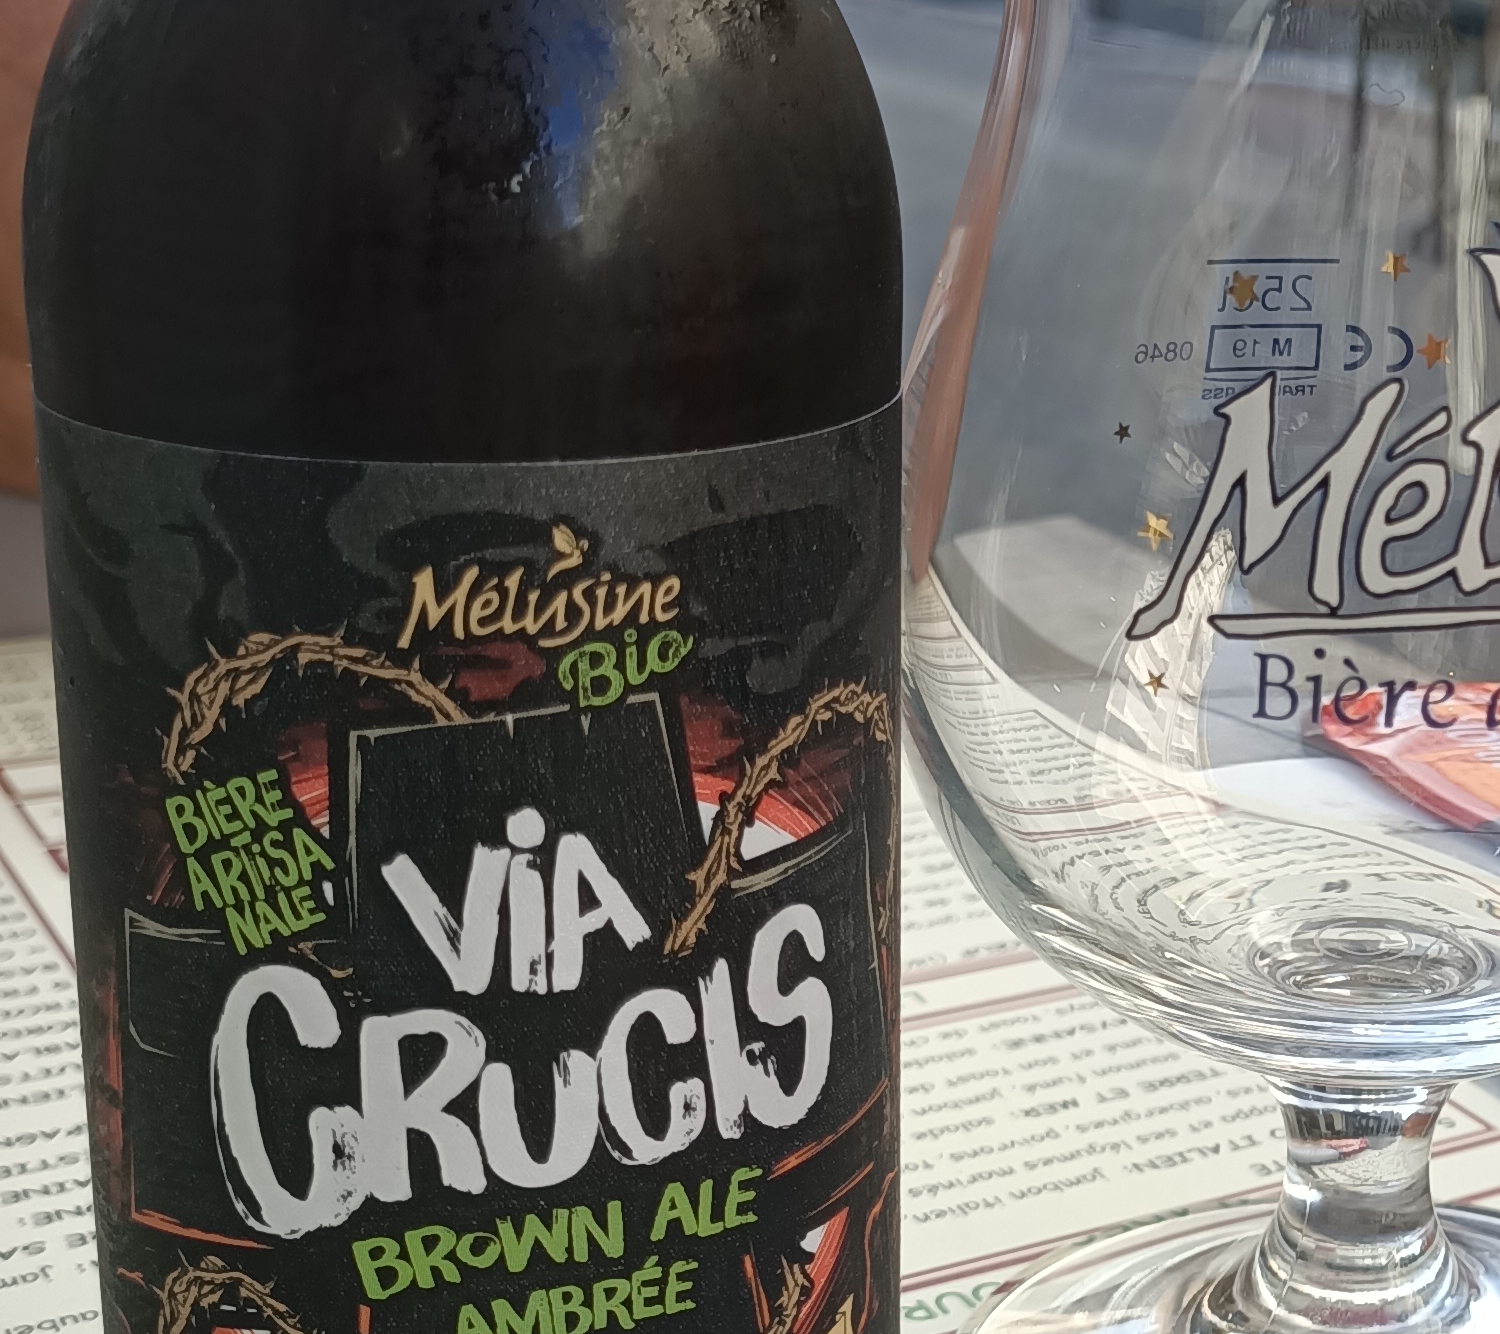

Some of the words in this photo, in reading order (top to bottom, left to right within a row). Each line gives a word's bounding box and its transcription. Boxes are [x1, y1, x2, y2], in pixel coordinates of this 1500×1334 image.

[396, 564, 681, 649] Mélusine
[557, 628, 694, 708] Bio
[1252, 643, 1457, 730] Bière
[165, 768, 294, 855] BIÈRE
[225, 885, 327, 956] NALE
[351, 1199, 625, 1300] BROWN
[649, 1166, 763, 1242] ALE
